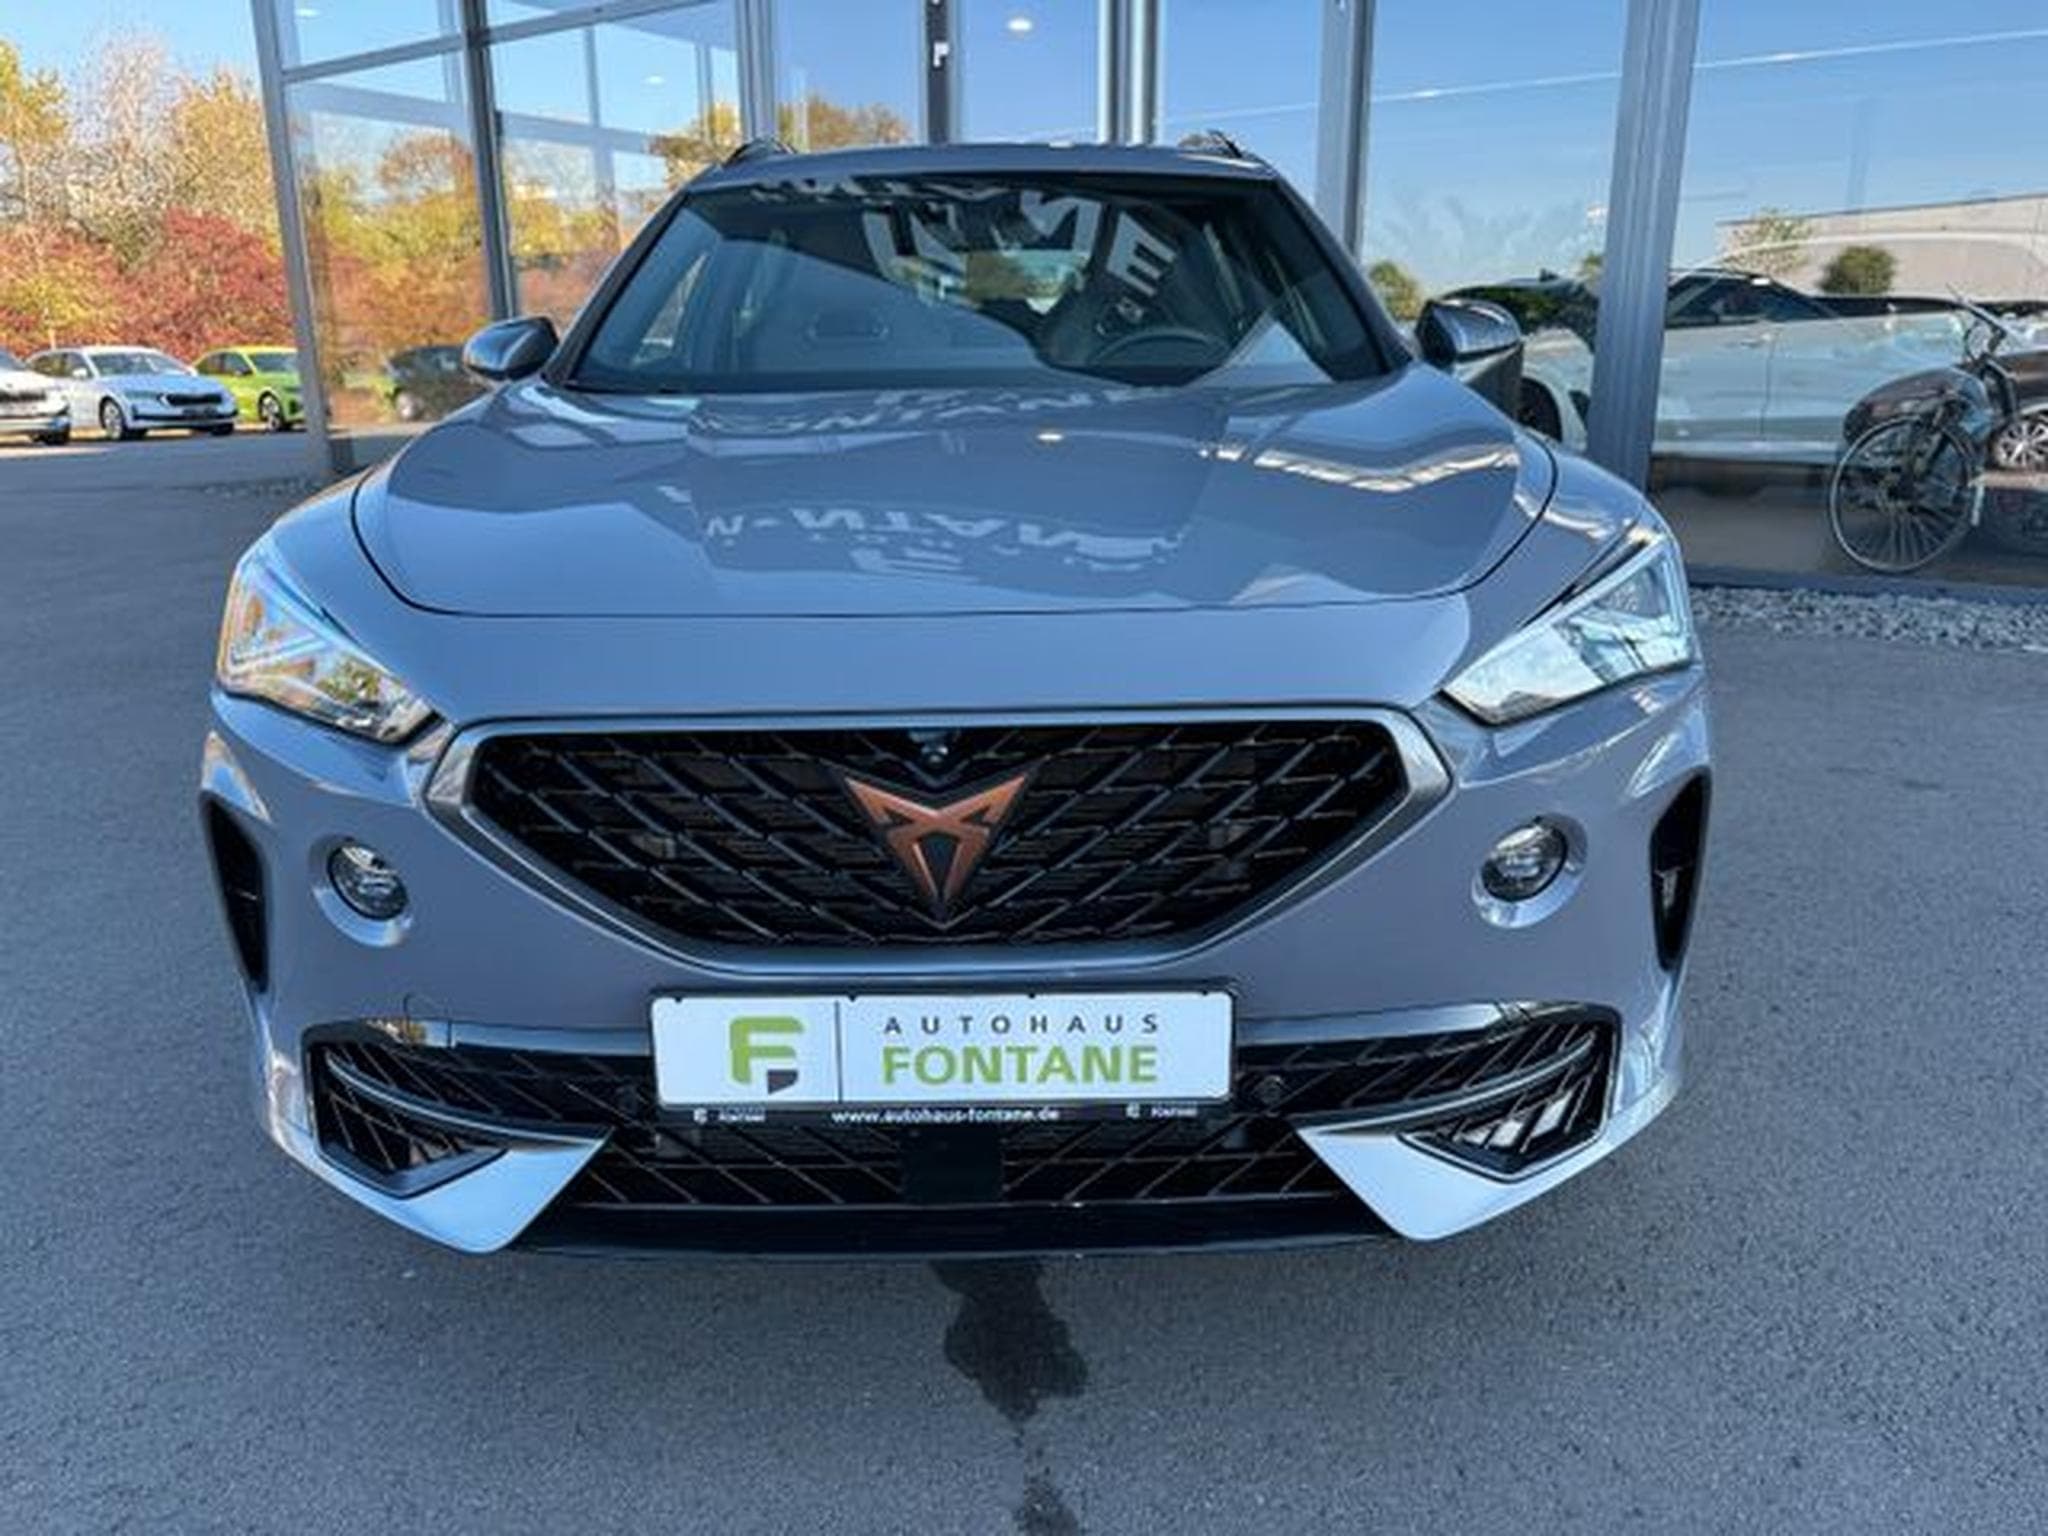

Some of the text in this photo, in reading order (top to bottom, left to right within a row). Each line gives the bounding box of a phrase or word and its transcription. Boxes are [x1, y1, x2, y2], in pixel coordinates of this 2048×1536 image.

[883, 1013, 1159, 1034] AUTOHAUS
[882, 1045, 1159, 1085] FONTANE
[831, 1106, 1060, 1124] www.autohaus-fontane.de
